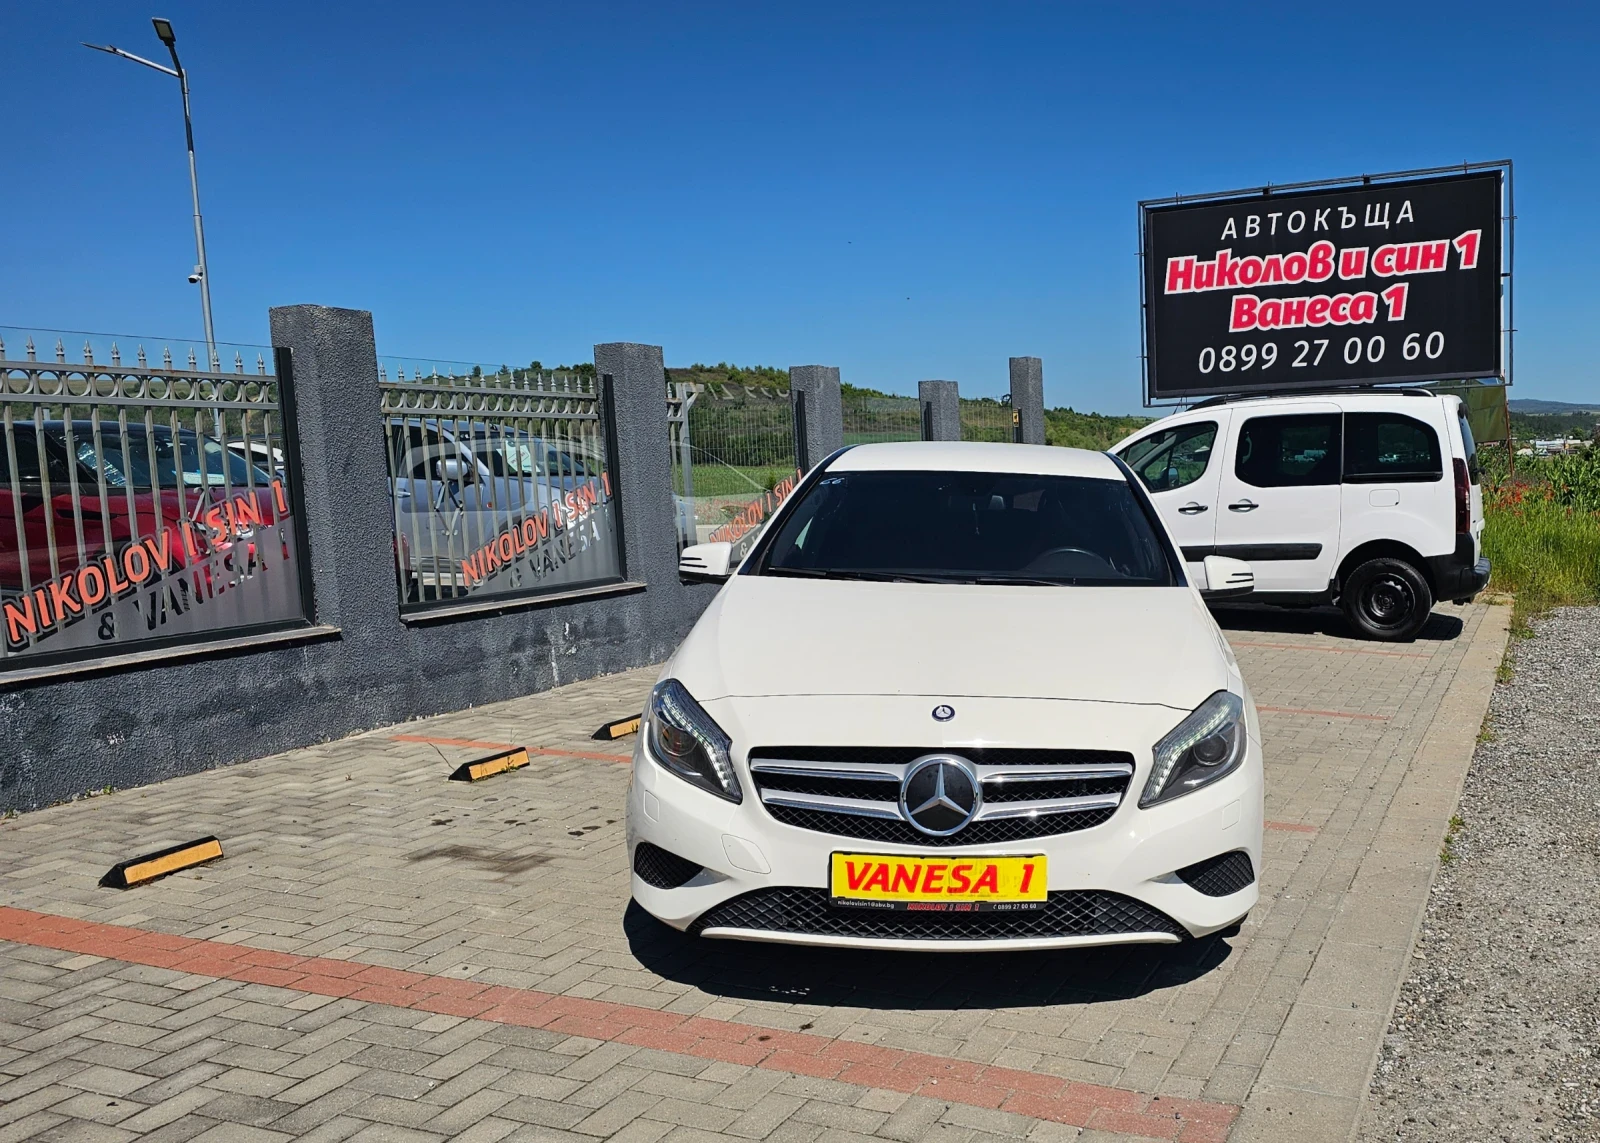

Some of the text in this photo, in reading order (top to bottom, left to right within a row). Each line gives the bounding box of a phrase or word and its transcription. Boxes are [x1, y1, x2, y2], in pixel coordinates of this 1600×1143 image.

[1221, 200, 1414, 240] АВТОКЪЩА
[1165, 229, 1482, 294] Николов и син 1
[1229, 282, 1409, 332] Ванеса 1
[1199, 331, 1444, 373] 0899 27 00 60
[461, 509, 548, 587] NIKOLOV
[565, 481, 597, 520] SIN
[709, 497, 763, 542] NIKOLOV
[773, 476, 794, 506] SIN
[4, 530, 171, 642] NIKOLOV
[205, 490, 262, 546] SIN
[529, 519, 600, 582] VANESA
[97, 612, 116, 640] &
[133, 543, 268, 631] VANESA
[845, 861, 1035, 893] VANESA 1
